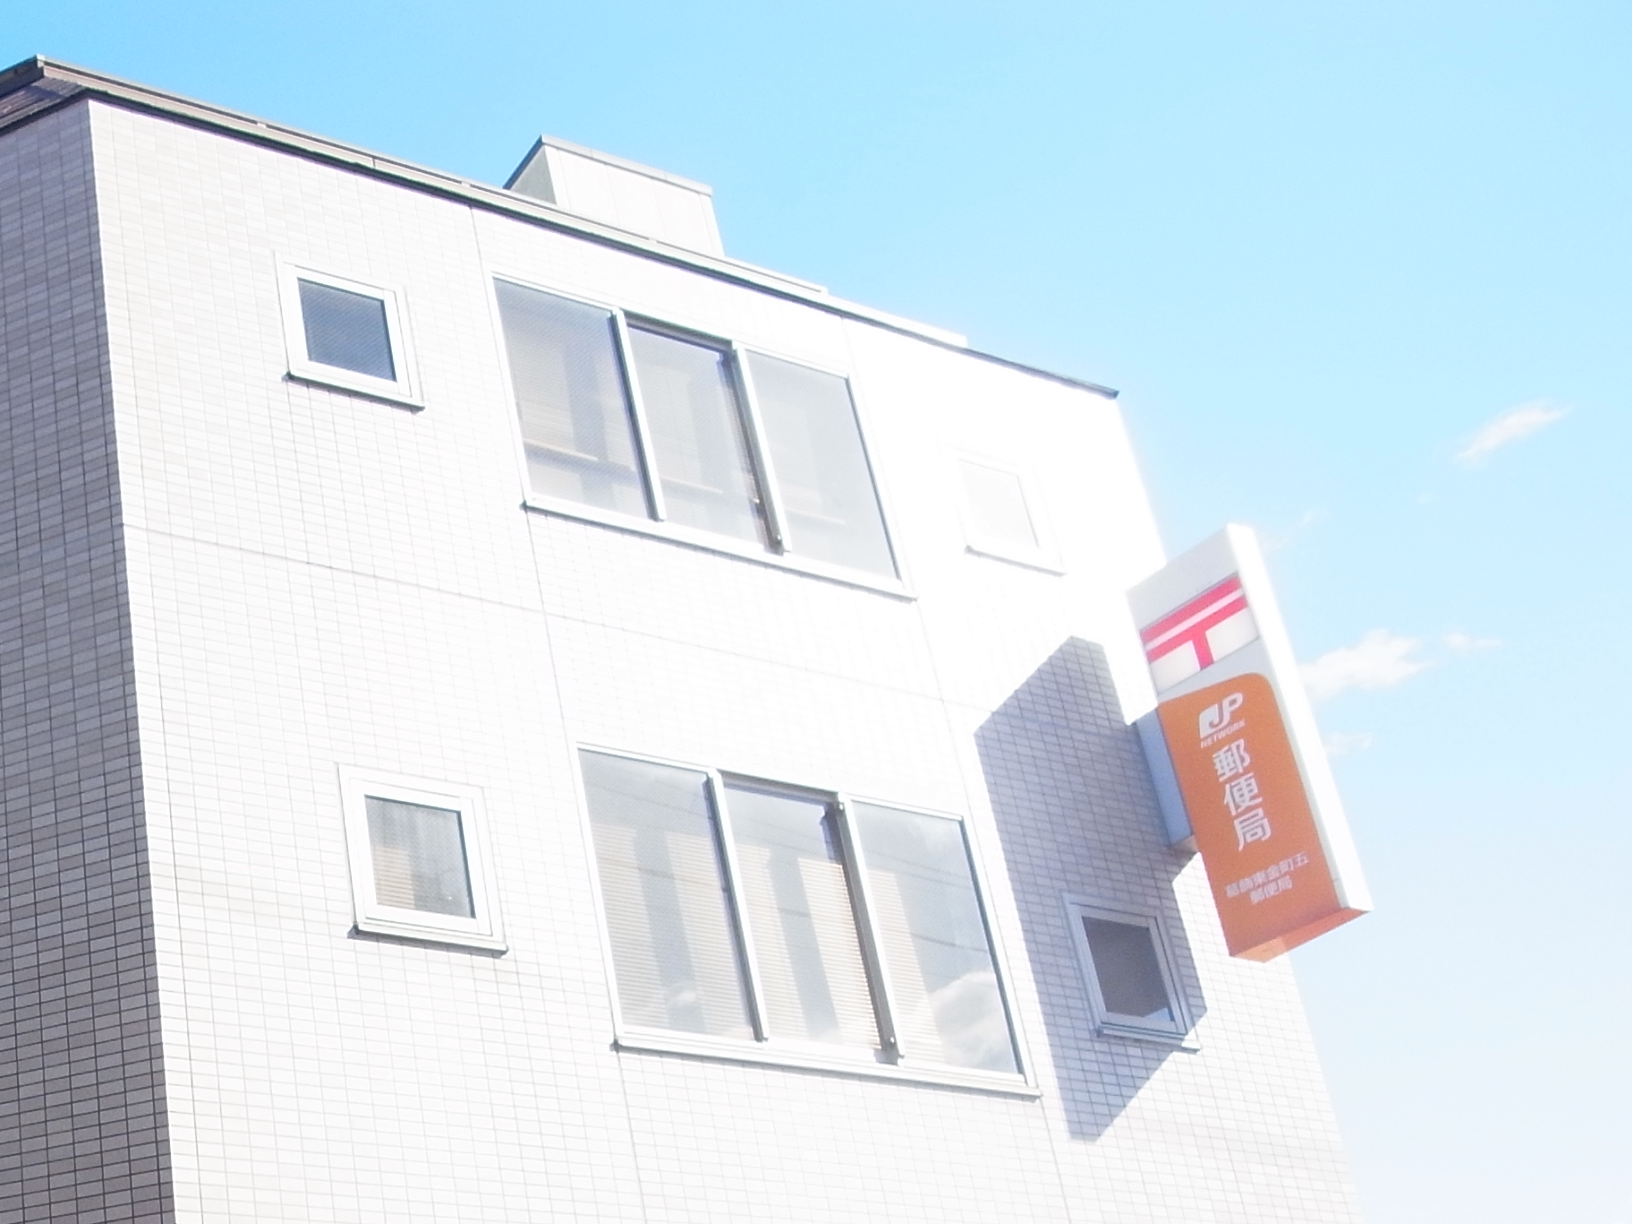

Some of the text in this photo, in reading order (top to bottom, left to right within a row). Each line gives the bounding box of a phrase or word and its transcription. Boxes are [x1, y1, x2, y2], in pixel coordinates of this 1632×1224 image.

[1200, 719, 1246, 749] NETWORK
[1212, 738, 1272, 852] 郵便局
[1249, 875, 1293, 905] 郵便局
